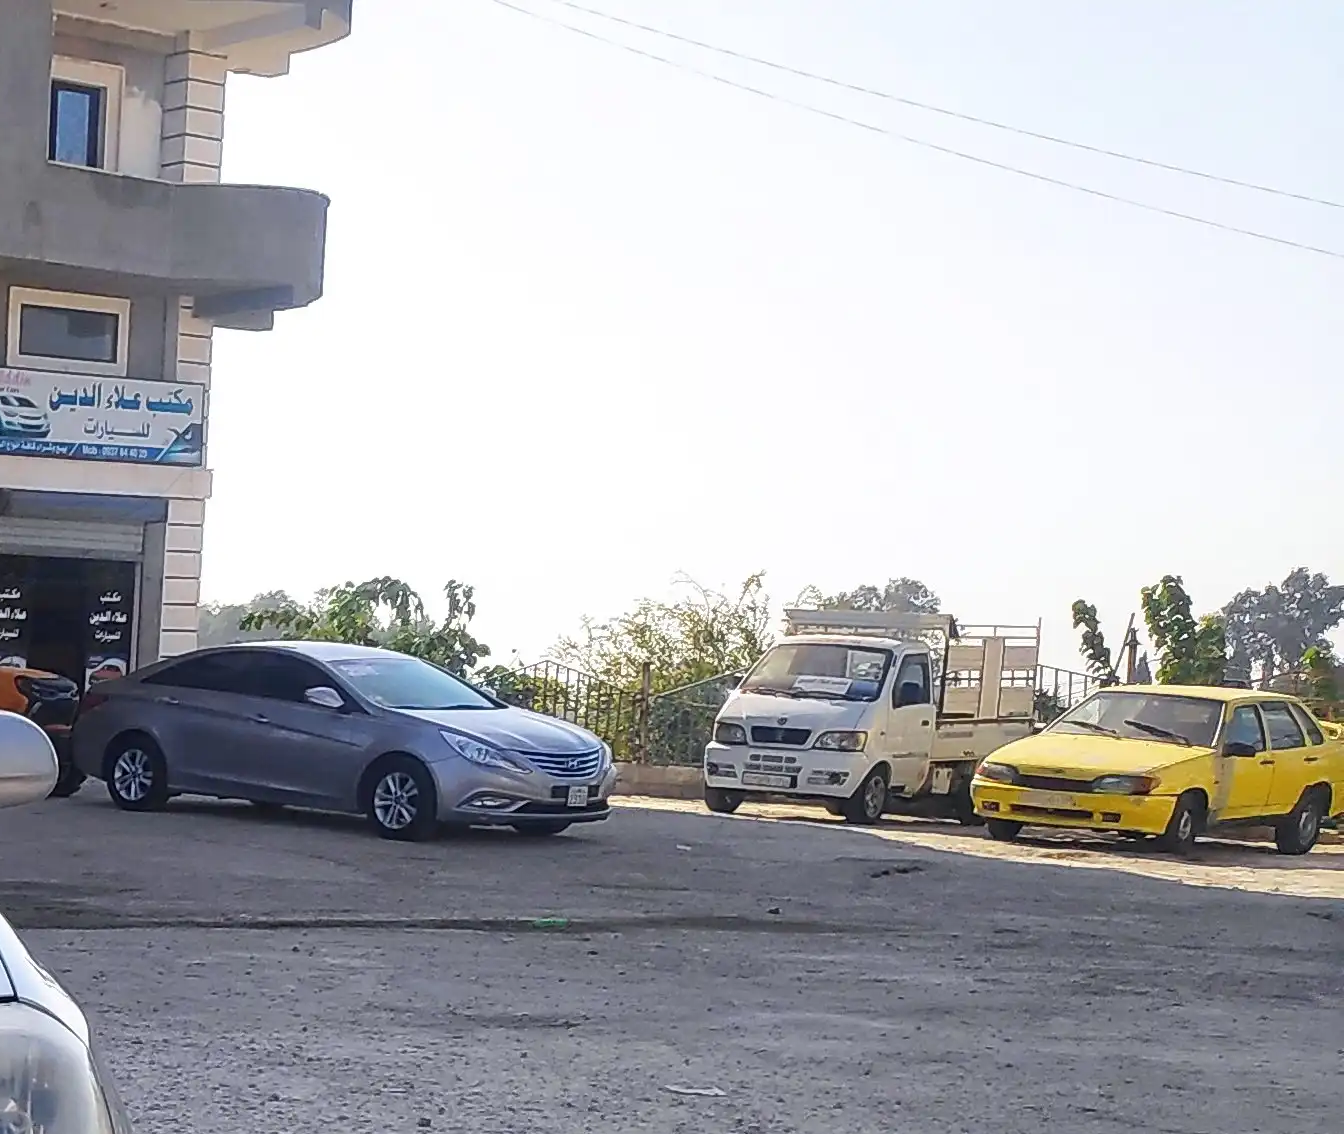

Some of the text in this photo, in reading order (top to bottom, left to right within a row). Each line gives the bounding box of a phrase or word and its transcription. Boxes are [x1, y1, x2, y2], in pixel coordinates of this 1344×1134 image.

[49, 382, 194, 418] مكتب علاء الدين
[83, 417, 151, 440] للسيارات
[99, 591, 121, 605] مكتب
[11, 608, 27, 620] علاء
[89, 610, 127, 625] علاء الدين
